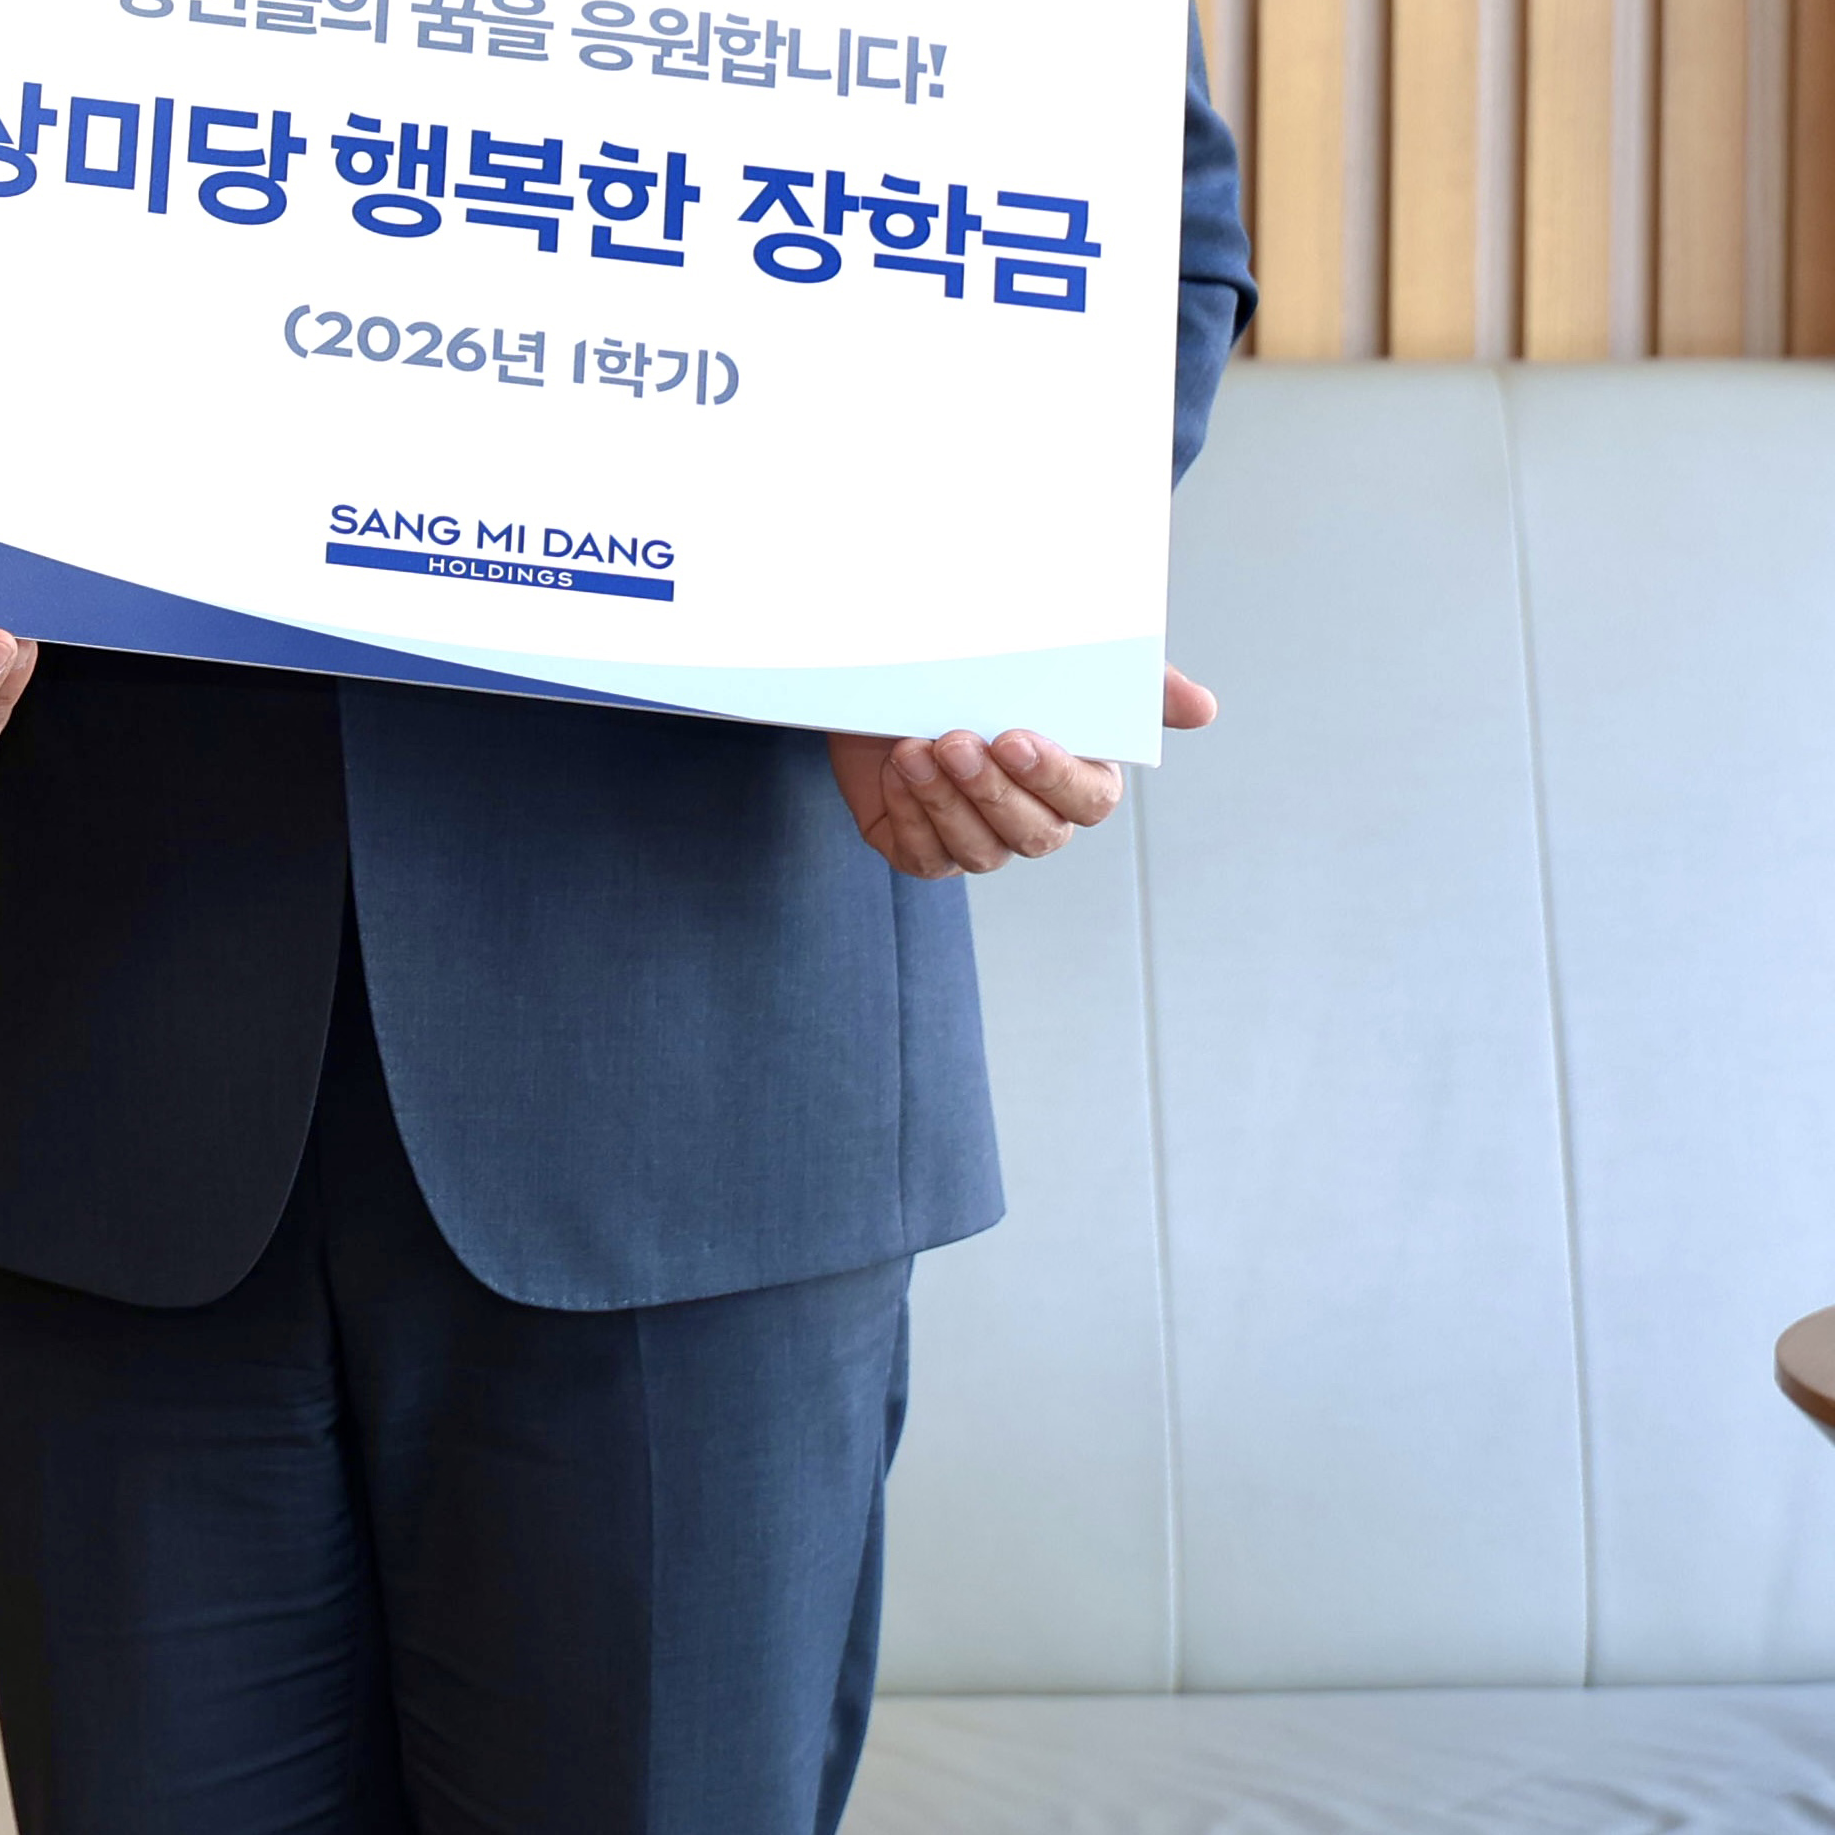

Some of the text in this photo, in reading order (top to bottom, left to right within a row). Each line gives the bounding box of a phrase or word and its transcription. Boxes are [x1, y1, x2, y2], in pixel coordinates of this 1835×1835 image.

[570, 0, 948, 105] 응원합니다!
[330, 112, 702, 268] 행복한
[737, 164, 1102, 314] 장학금
[283, 304, 740, 406] (2026년 1학기)
[329, 504, 675, 570] SANG MI DANG
[428, 557, 574, 588] HOLDINGS
